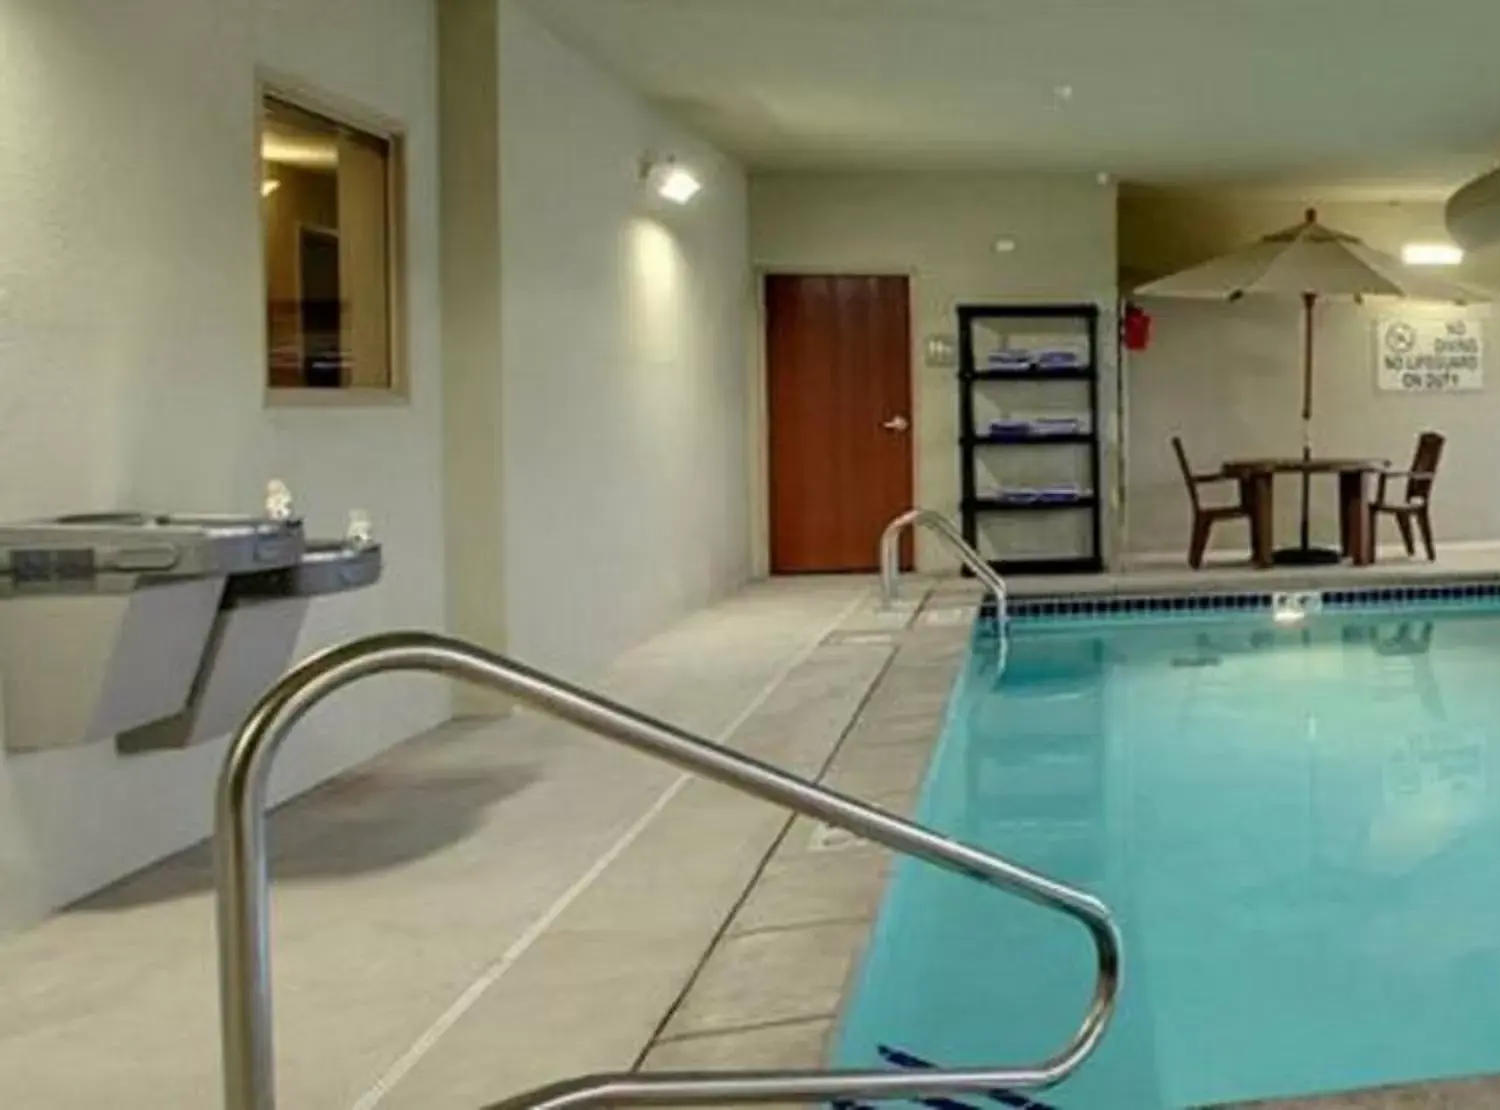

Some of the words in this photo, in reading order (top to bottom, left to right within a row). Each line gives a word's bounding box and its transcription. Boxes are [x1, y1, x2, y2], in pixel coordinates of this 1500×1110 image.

[1384, 354, 1403, 370] NO
[1402, 372, 1422, 388] ON
[1426, 372, 1460, 388] DUTY
